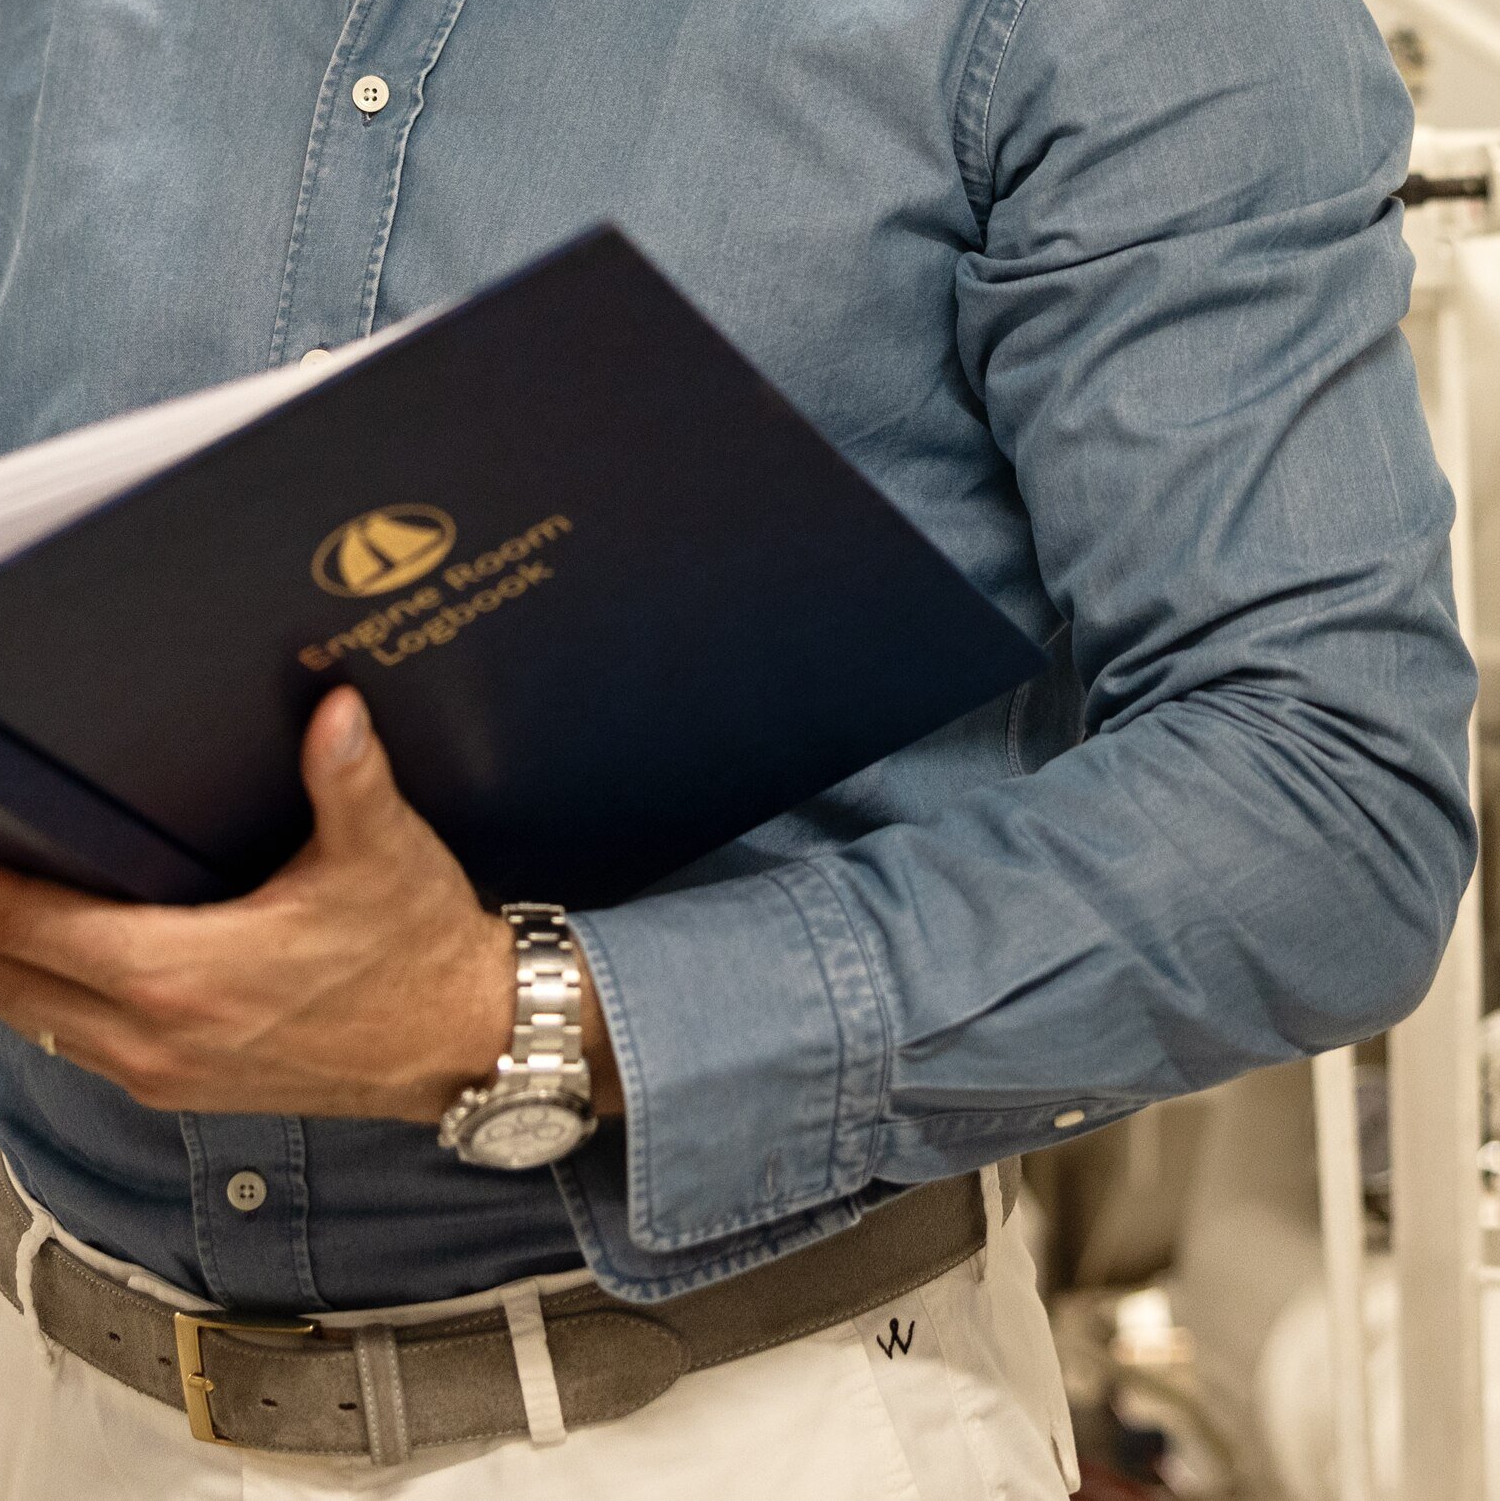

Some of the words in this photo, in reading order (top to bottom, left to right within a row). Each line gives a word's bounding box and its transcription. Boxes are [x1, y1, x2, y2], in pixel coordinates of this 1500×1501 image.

[299, 586, 440, 671] Engine
[443, 513, 574, 591] Room
[372, 561, 555, 666] Logbook
